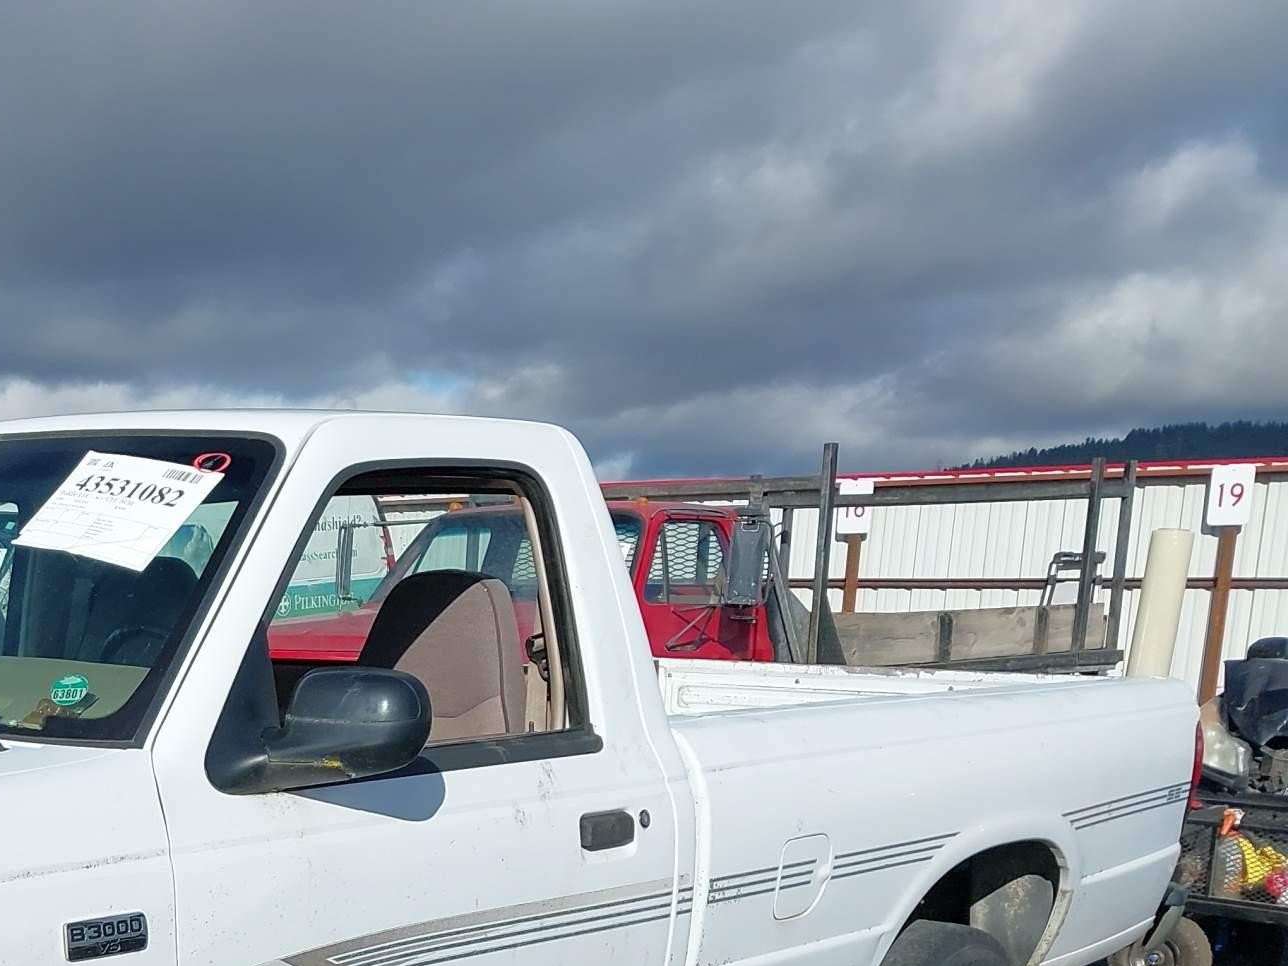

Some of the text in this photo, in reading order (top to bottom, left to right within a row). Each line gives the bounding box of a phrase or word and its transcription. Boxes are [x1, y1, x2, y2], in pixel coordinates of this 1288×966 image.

[75, 473, 185, 508] 43531082
[1217, 482, 1245, 508] 19
[53, 688, 83, 699] 63801
[70, 915, 143, 942] B3000
[97, 939, 121, 954] V6
